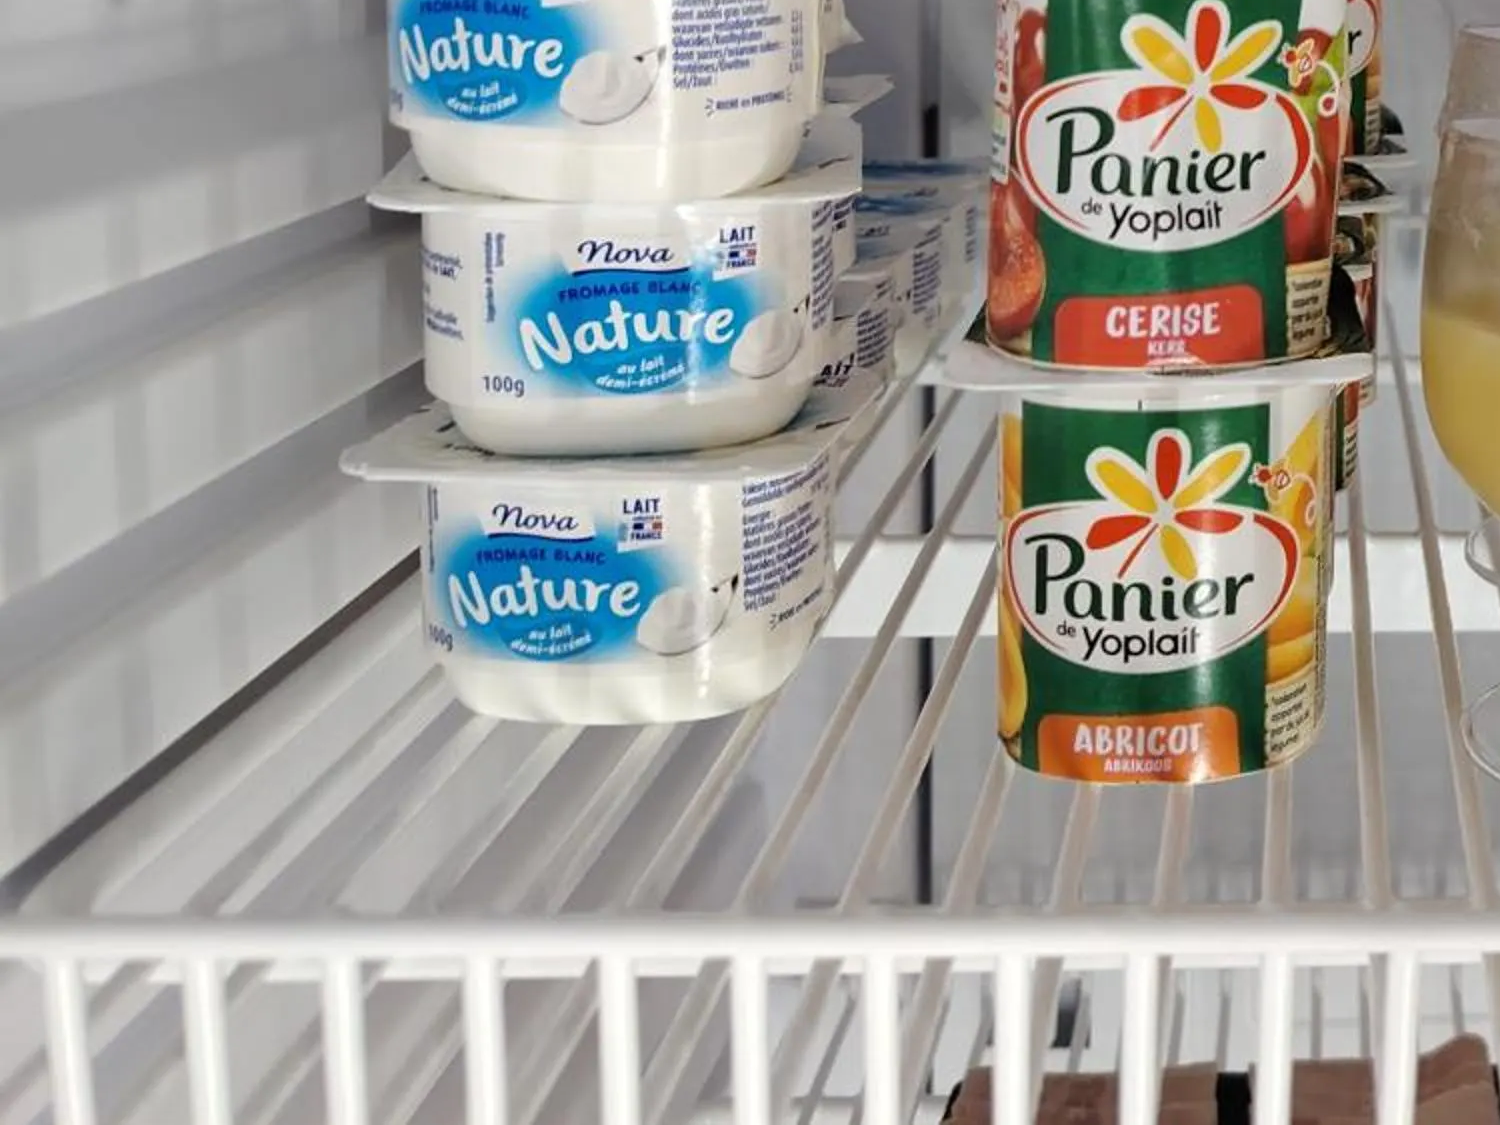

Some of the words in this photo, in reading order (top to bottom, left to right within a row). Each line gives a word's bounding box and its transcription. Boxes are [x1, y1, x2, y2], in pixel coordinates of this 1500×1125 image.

[420, 0, 478, 15] FROMAGE
[484, 0, 530, 19] BLANC
[400, 16, 563, 85] Nature
[462, 88, 477, 98] au
[480, 81, 499, 97] lait
[1045, 106, 1266, 198] Panier
[1081, 197, 1103, 216] de
[720, 225, 755, 243] LAIT
[577, 240, 674, 264] Nova
[726, 259, 756, 268] FRANCE
[559, 281, 639, 302] FROMAGE
[648, 279, 701, 296] BLANC
[1106, 302, 1220, 338] CERISE
[519, 300, 735, 371] Nature
[617, 364, 636, 374] au
[640, 354, 665, 371] lait
[482, 375, 525, 398] 100g
[491, 503, 578, 531] Nova
[623, 499, 660, 514] LAIT
[631, 531, 662, 540] FRANCE
[476, 549, 546, 564] FROMAGE
[554, 547, 606, 564] BLANC
[1025, 532, 1255, 623] Panier
[448, 565, 640, 628] Nature
[528, 630, 546, 640] au
[550, 623, 572, 639] lait
[1057, 621, 1076, 637] de
[510, 629, 592, 655] demi-écrémé
[1074, 723, 1203, 755] ABRICOT
